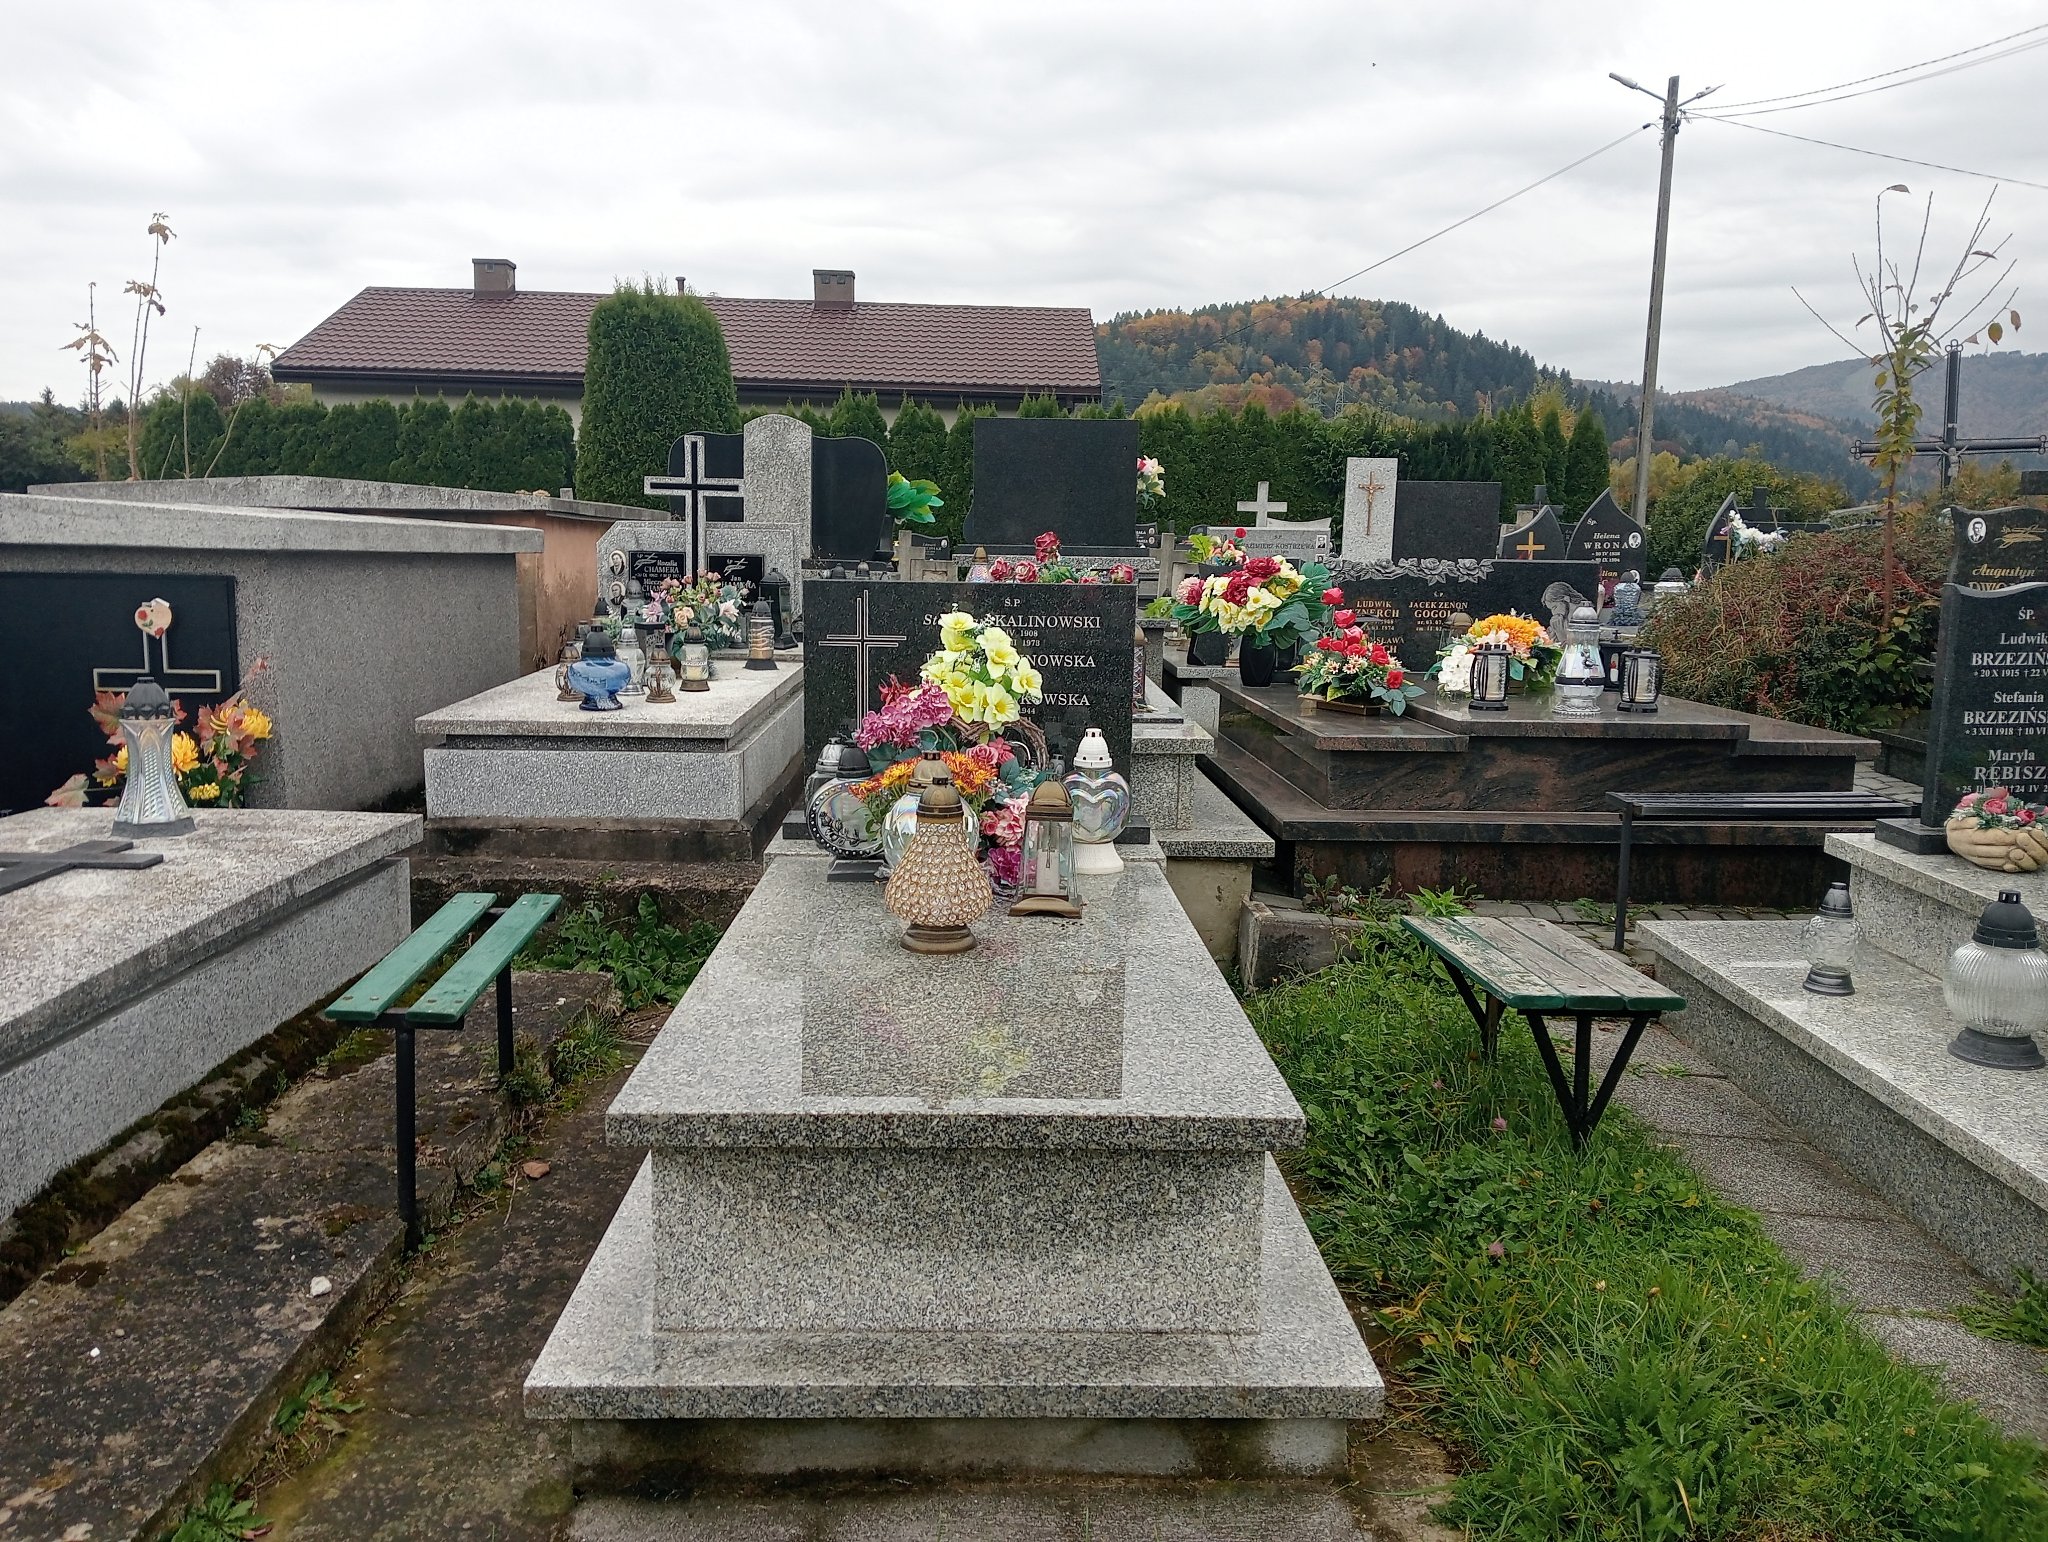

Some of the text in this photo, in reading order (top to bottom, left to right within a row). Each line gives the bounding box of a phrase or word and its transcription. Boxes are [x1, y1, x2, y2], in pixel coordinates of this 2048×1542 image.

[1584, 541, 1629, 550] WRONA
[1972, 563, 2036, 579] Augustyn
[1356, 600, 1392, 608] LUDWIK
[1408, 601, 1469, 610] JACEK ZENON
[994, 614, 1101, 629] KALINOWSKI
[1020, 629, 1039, 637] 1908
[2000, 632, 2048, 645] Ludwik
[1022, 654, 1097, 668] NOWSKA
[2001, 668, 2020, 677] 1915
[1994, 690, 2045, 703] Stefania
[1963, 706, 2048, 725] BRZEZIŃS
[1995, 727, 2014, 736] 1918
[1988, 749, 2036, 764] Maryla
